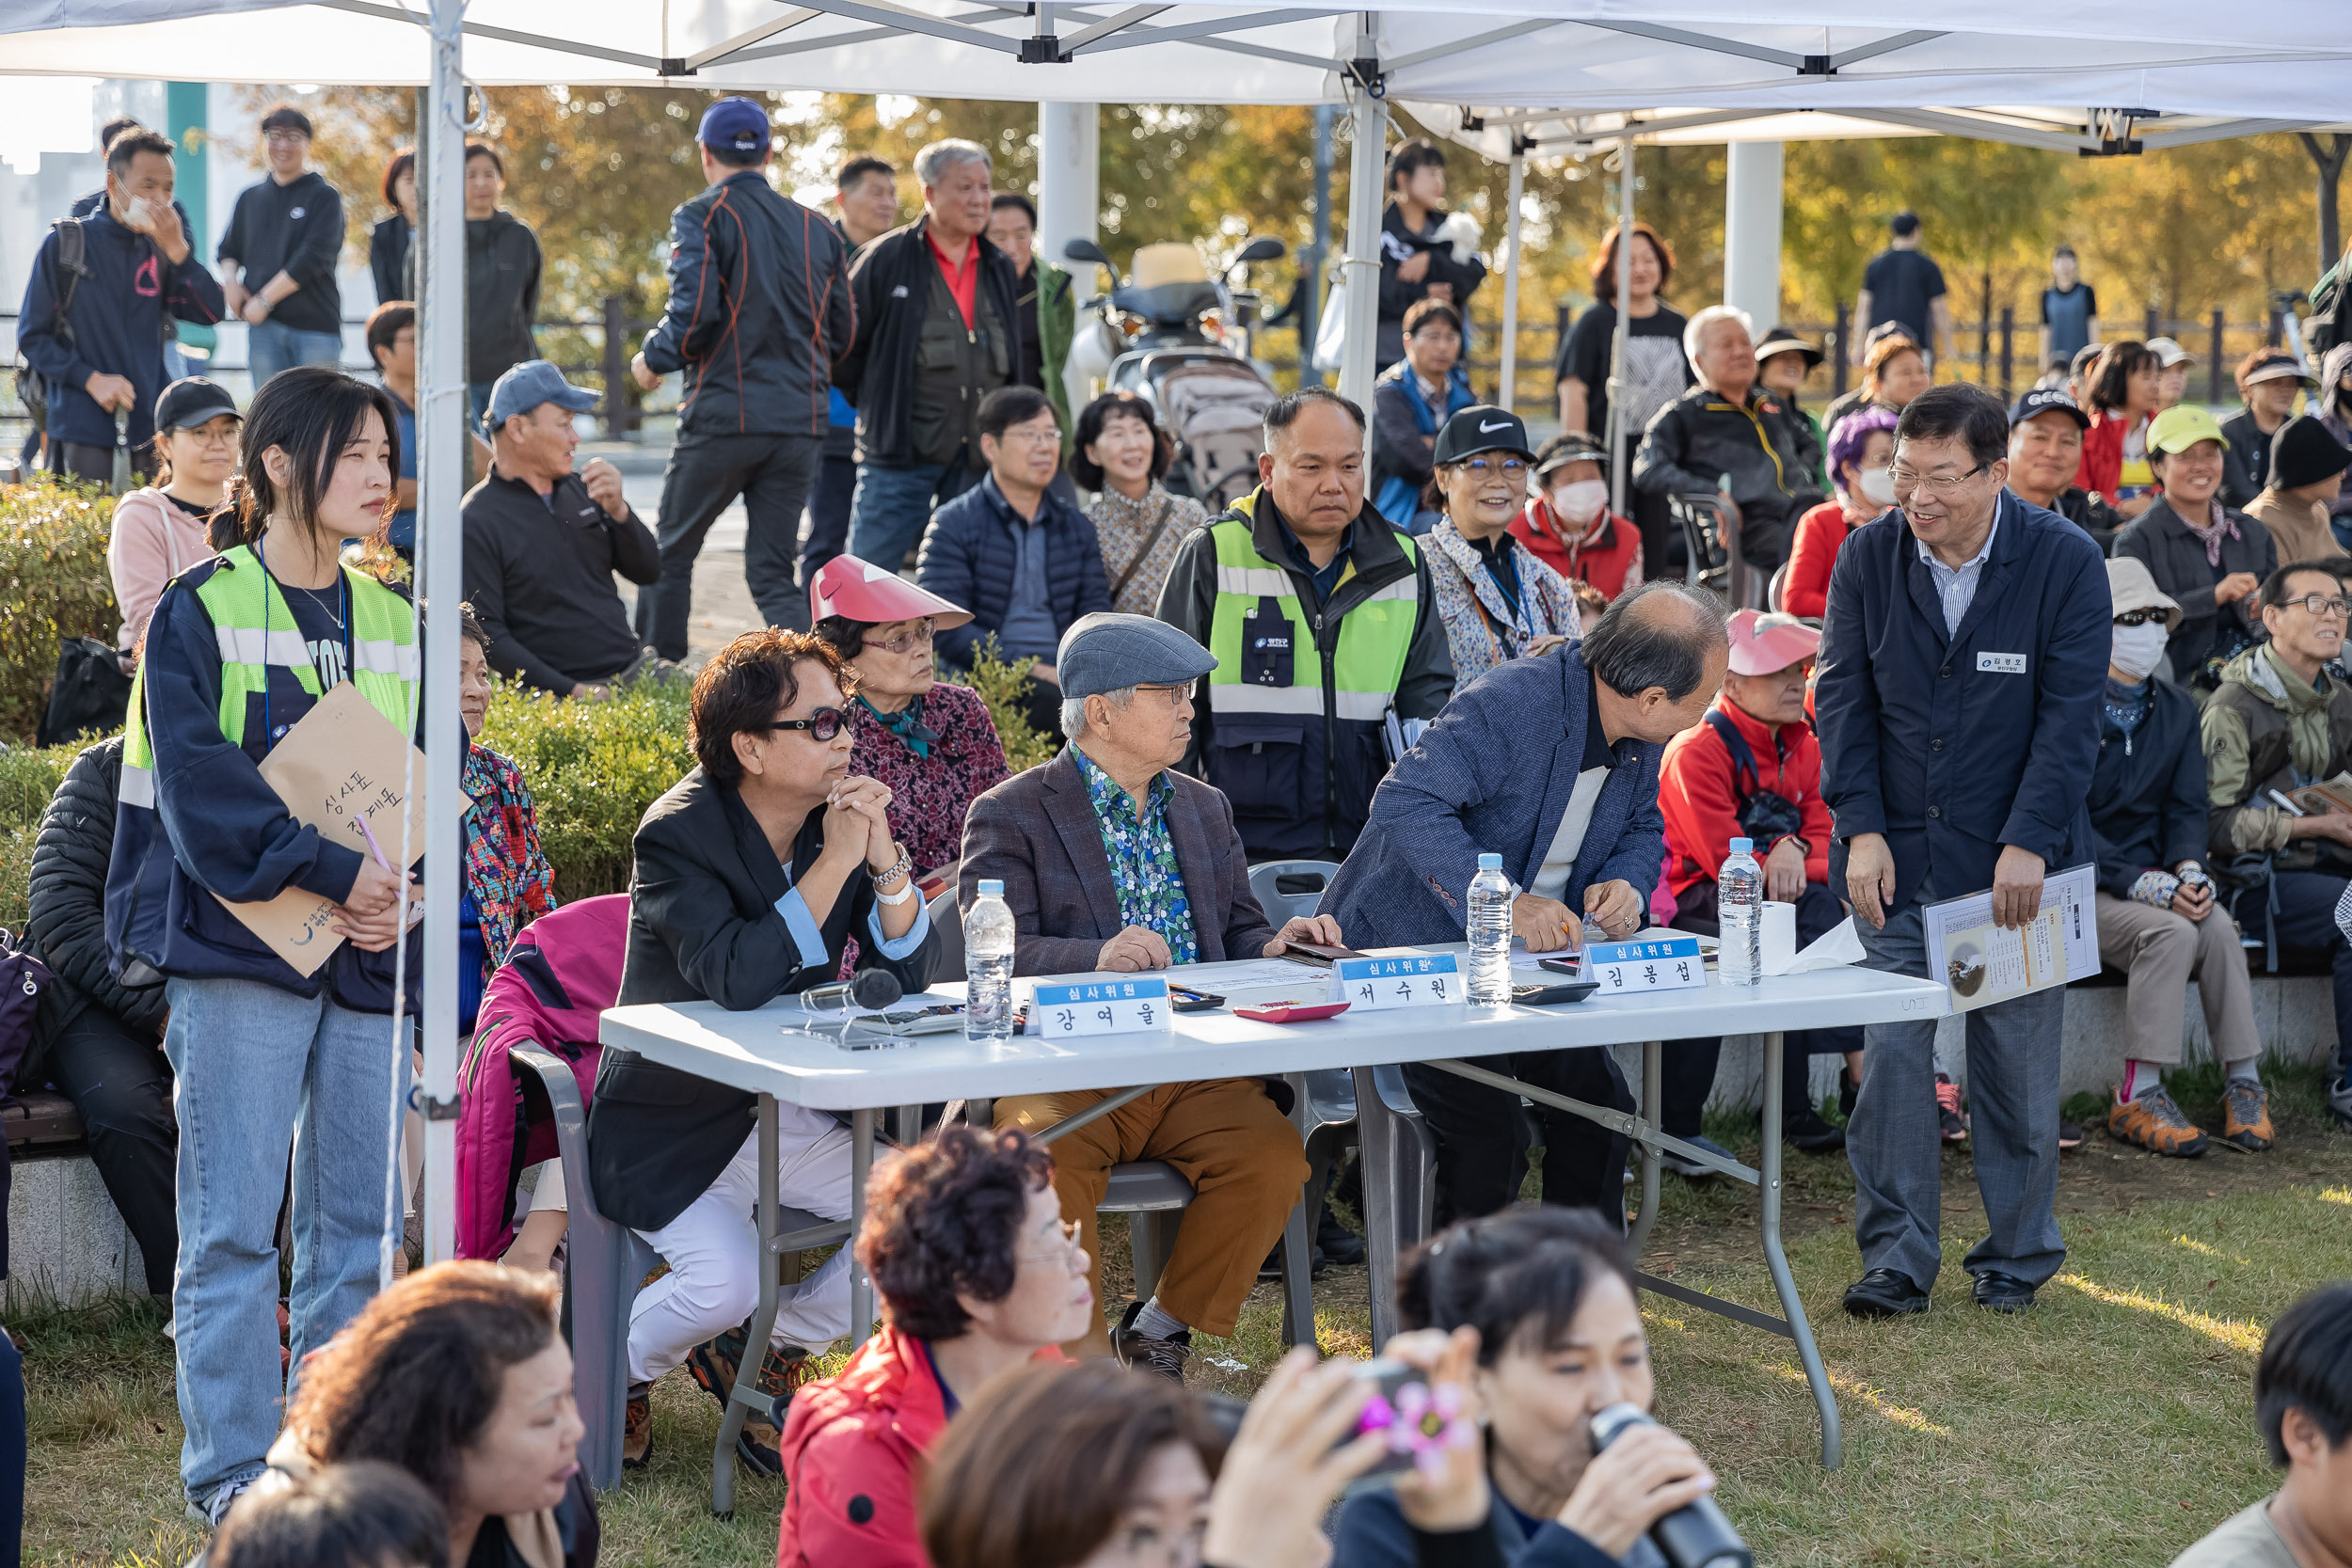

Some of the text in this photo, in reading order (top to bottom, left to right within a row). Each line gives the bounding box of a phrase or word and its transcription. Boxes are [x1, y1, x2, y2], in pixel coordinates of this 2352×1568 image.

[1616, 943, 1673, 959] 심사위원
[1369, 959, 1429, 975] 심사위원
[1068, 983, 1136, 1001] 심사위원
